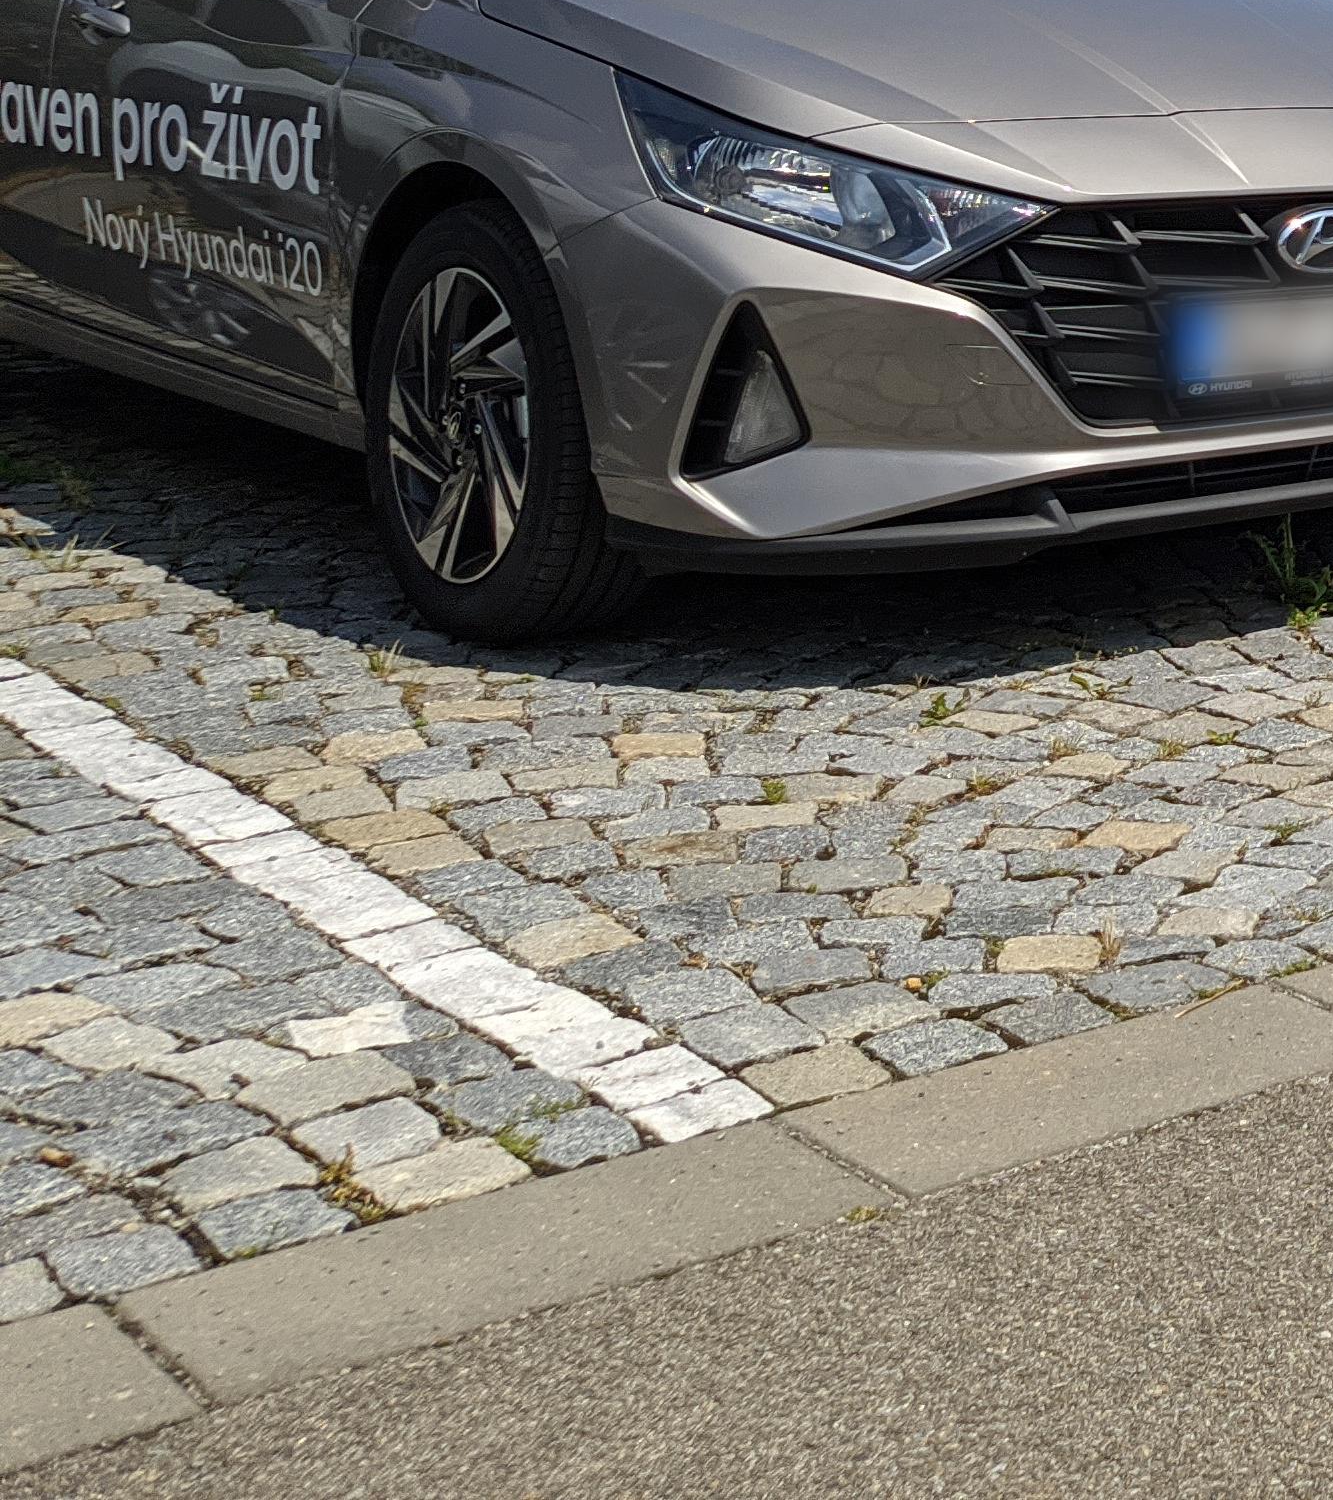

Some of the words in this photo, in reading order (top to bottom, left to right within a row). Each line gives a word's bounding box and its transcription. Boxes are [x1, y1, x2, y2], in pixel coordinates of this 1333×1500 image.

[0, 81, 101, 157] aven
[112, 98, 188, 181] pro
[202, 82, 321, 195] život
[82, 197, 149, 269] Nový
[154, 211, 275, 285] Hyundai
[276, 232, 322, 296] i20
[1209, 379, 1253, 393] HYUNDAI
